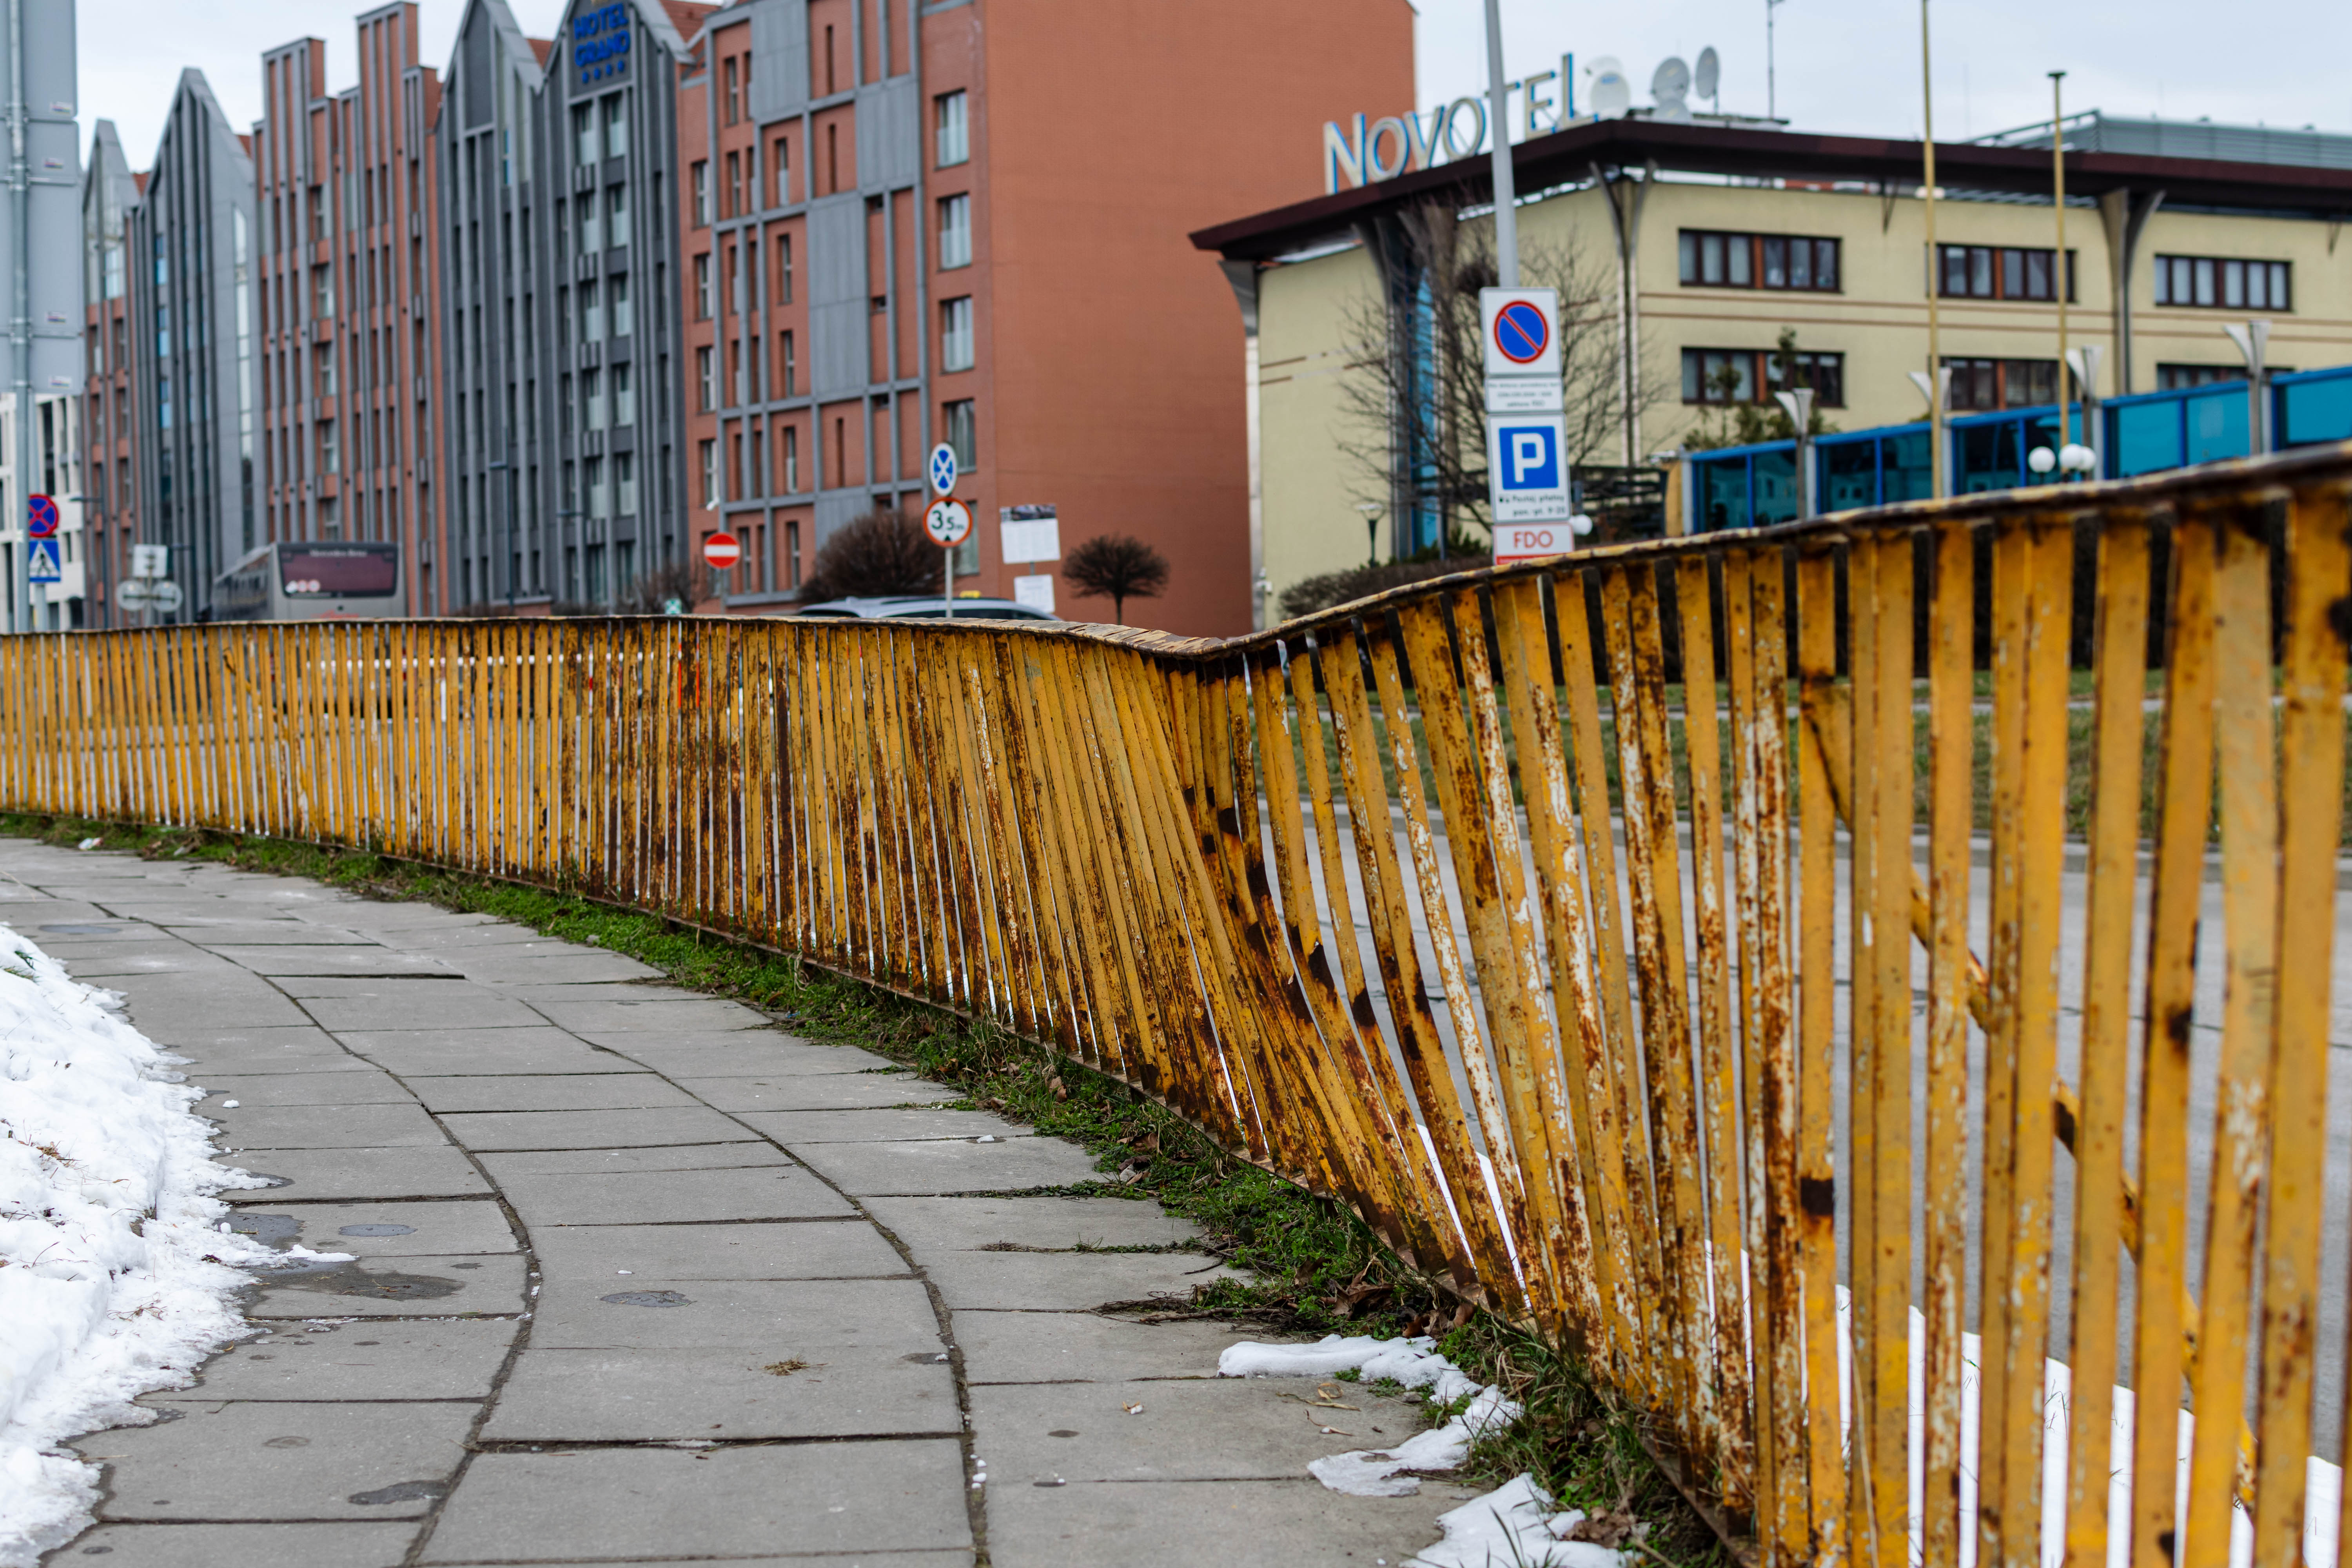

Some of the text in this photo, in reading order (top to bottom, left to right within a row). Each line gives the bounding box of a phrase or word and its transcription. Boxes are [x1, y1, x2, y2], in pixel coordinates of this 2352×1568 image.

[574, 3, 628, 40] HOTEL
[1512, 432, 1546, 483] P
[1514, 530, 1553, 549] FDO
